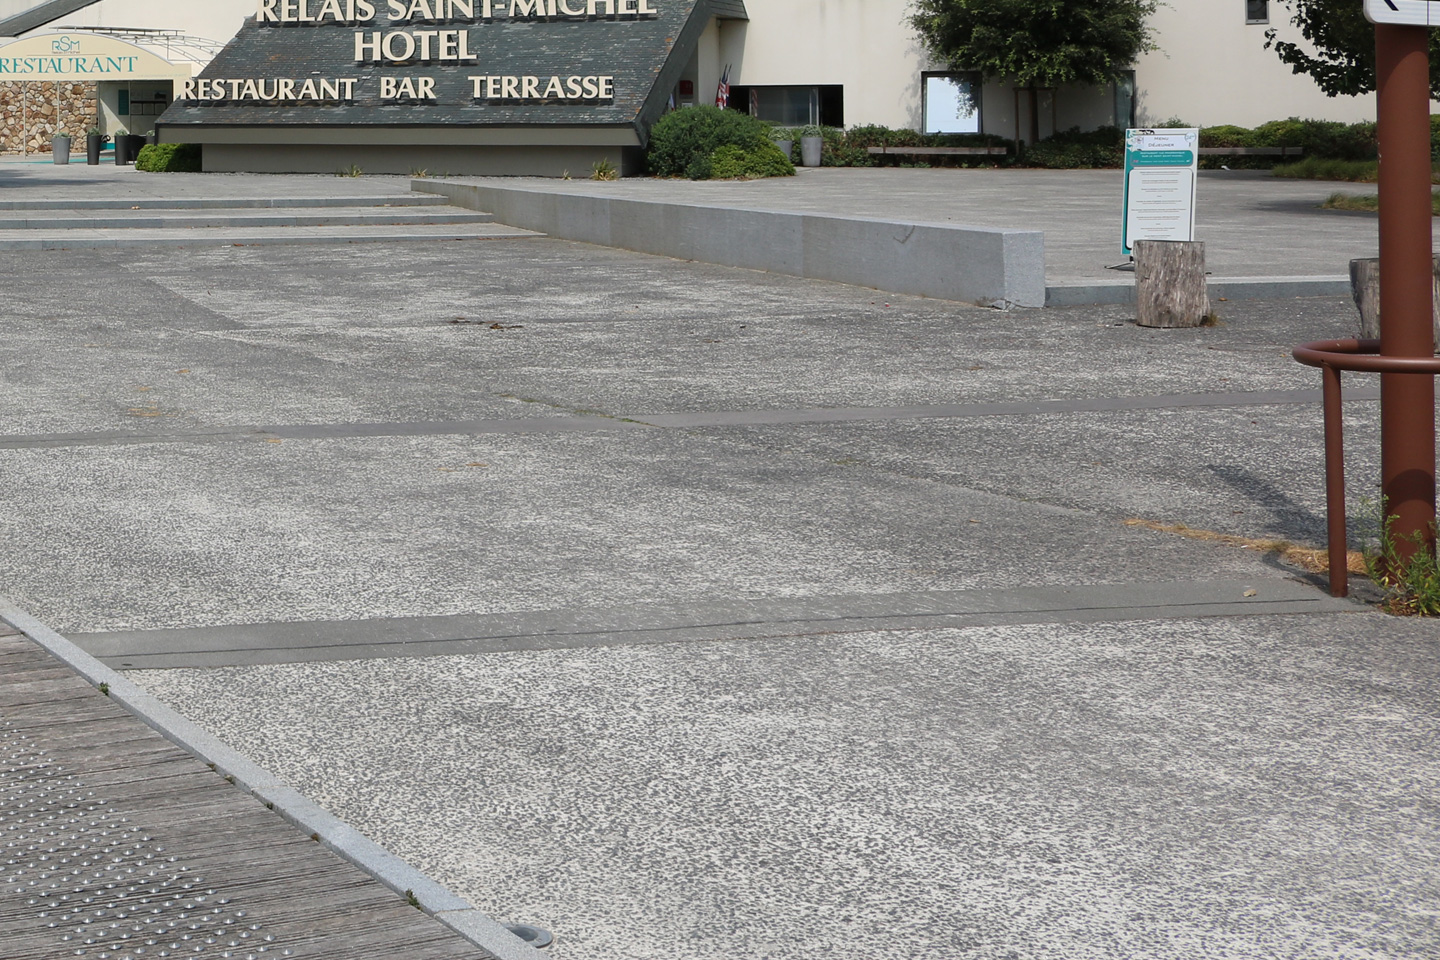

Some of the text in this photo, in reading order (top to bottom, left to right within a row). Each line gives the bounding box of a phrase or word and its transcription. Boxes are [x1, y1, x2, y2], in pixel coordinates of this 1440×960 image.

[354, 29, 477, 61] HOTEL
[180, 75, 614, 100] RESTAURANT BAR TERRASSE
